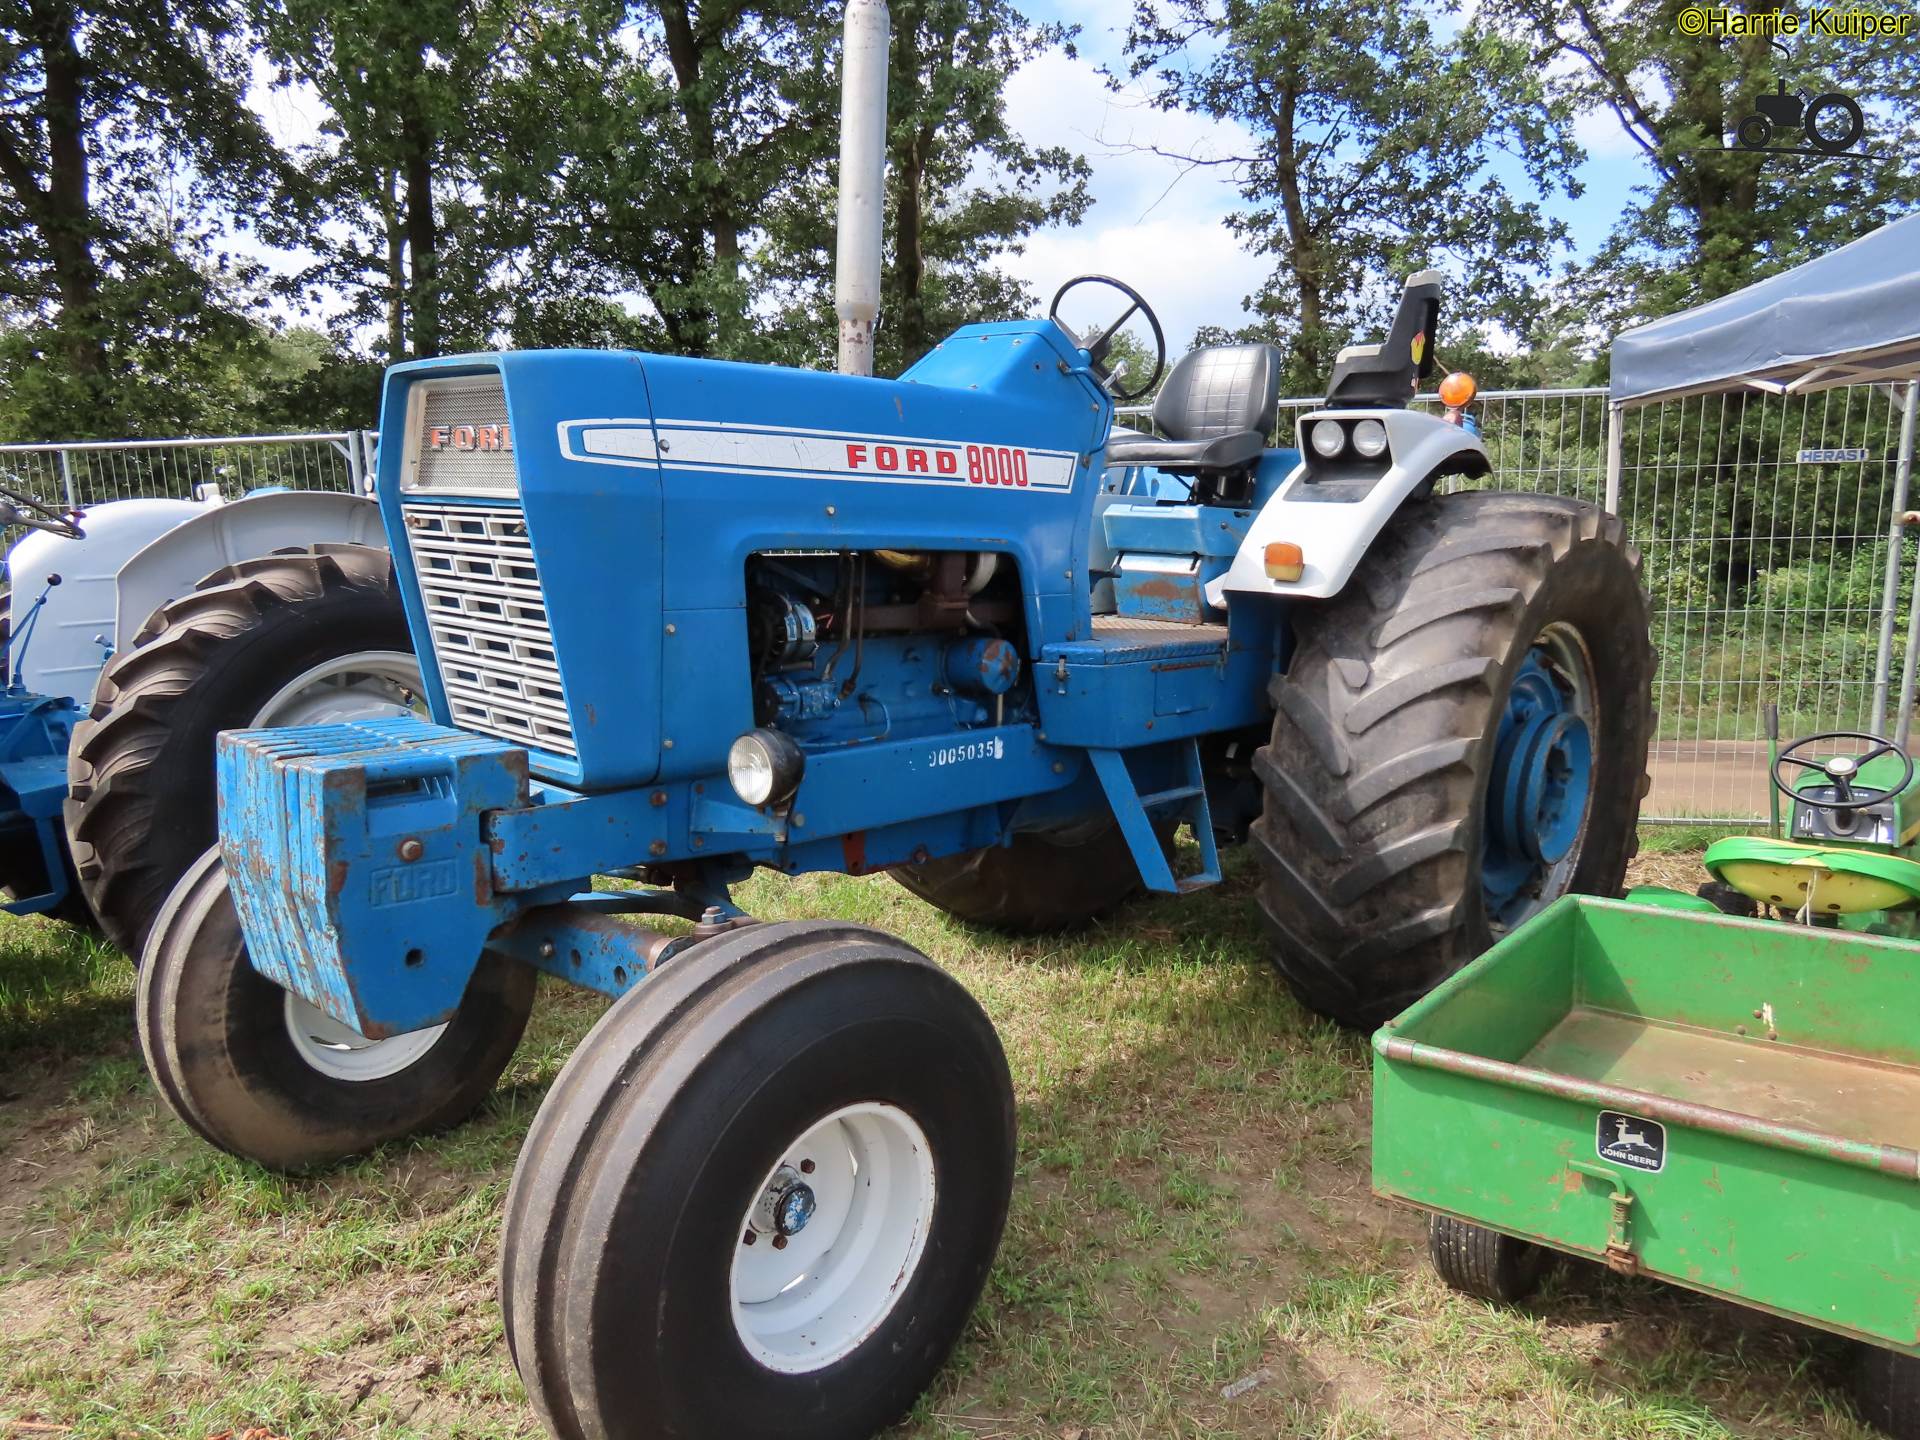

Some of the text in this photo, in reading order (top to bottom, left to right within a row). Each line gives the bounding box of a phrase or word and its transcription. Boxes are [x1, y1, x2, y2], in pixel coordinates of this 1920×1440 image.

[846, 444, 1028, 487] FORD 8000
[1800, 450, 1857, 462] HERAS
[369, 858, 458, 908] FORD
[1601, 1147, 1659, 1168] JOHN DEERE
